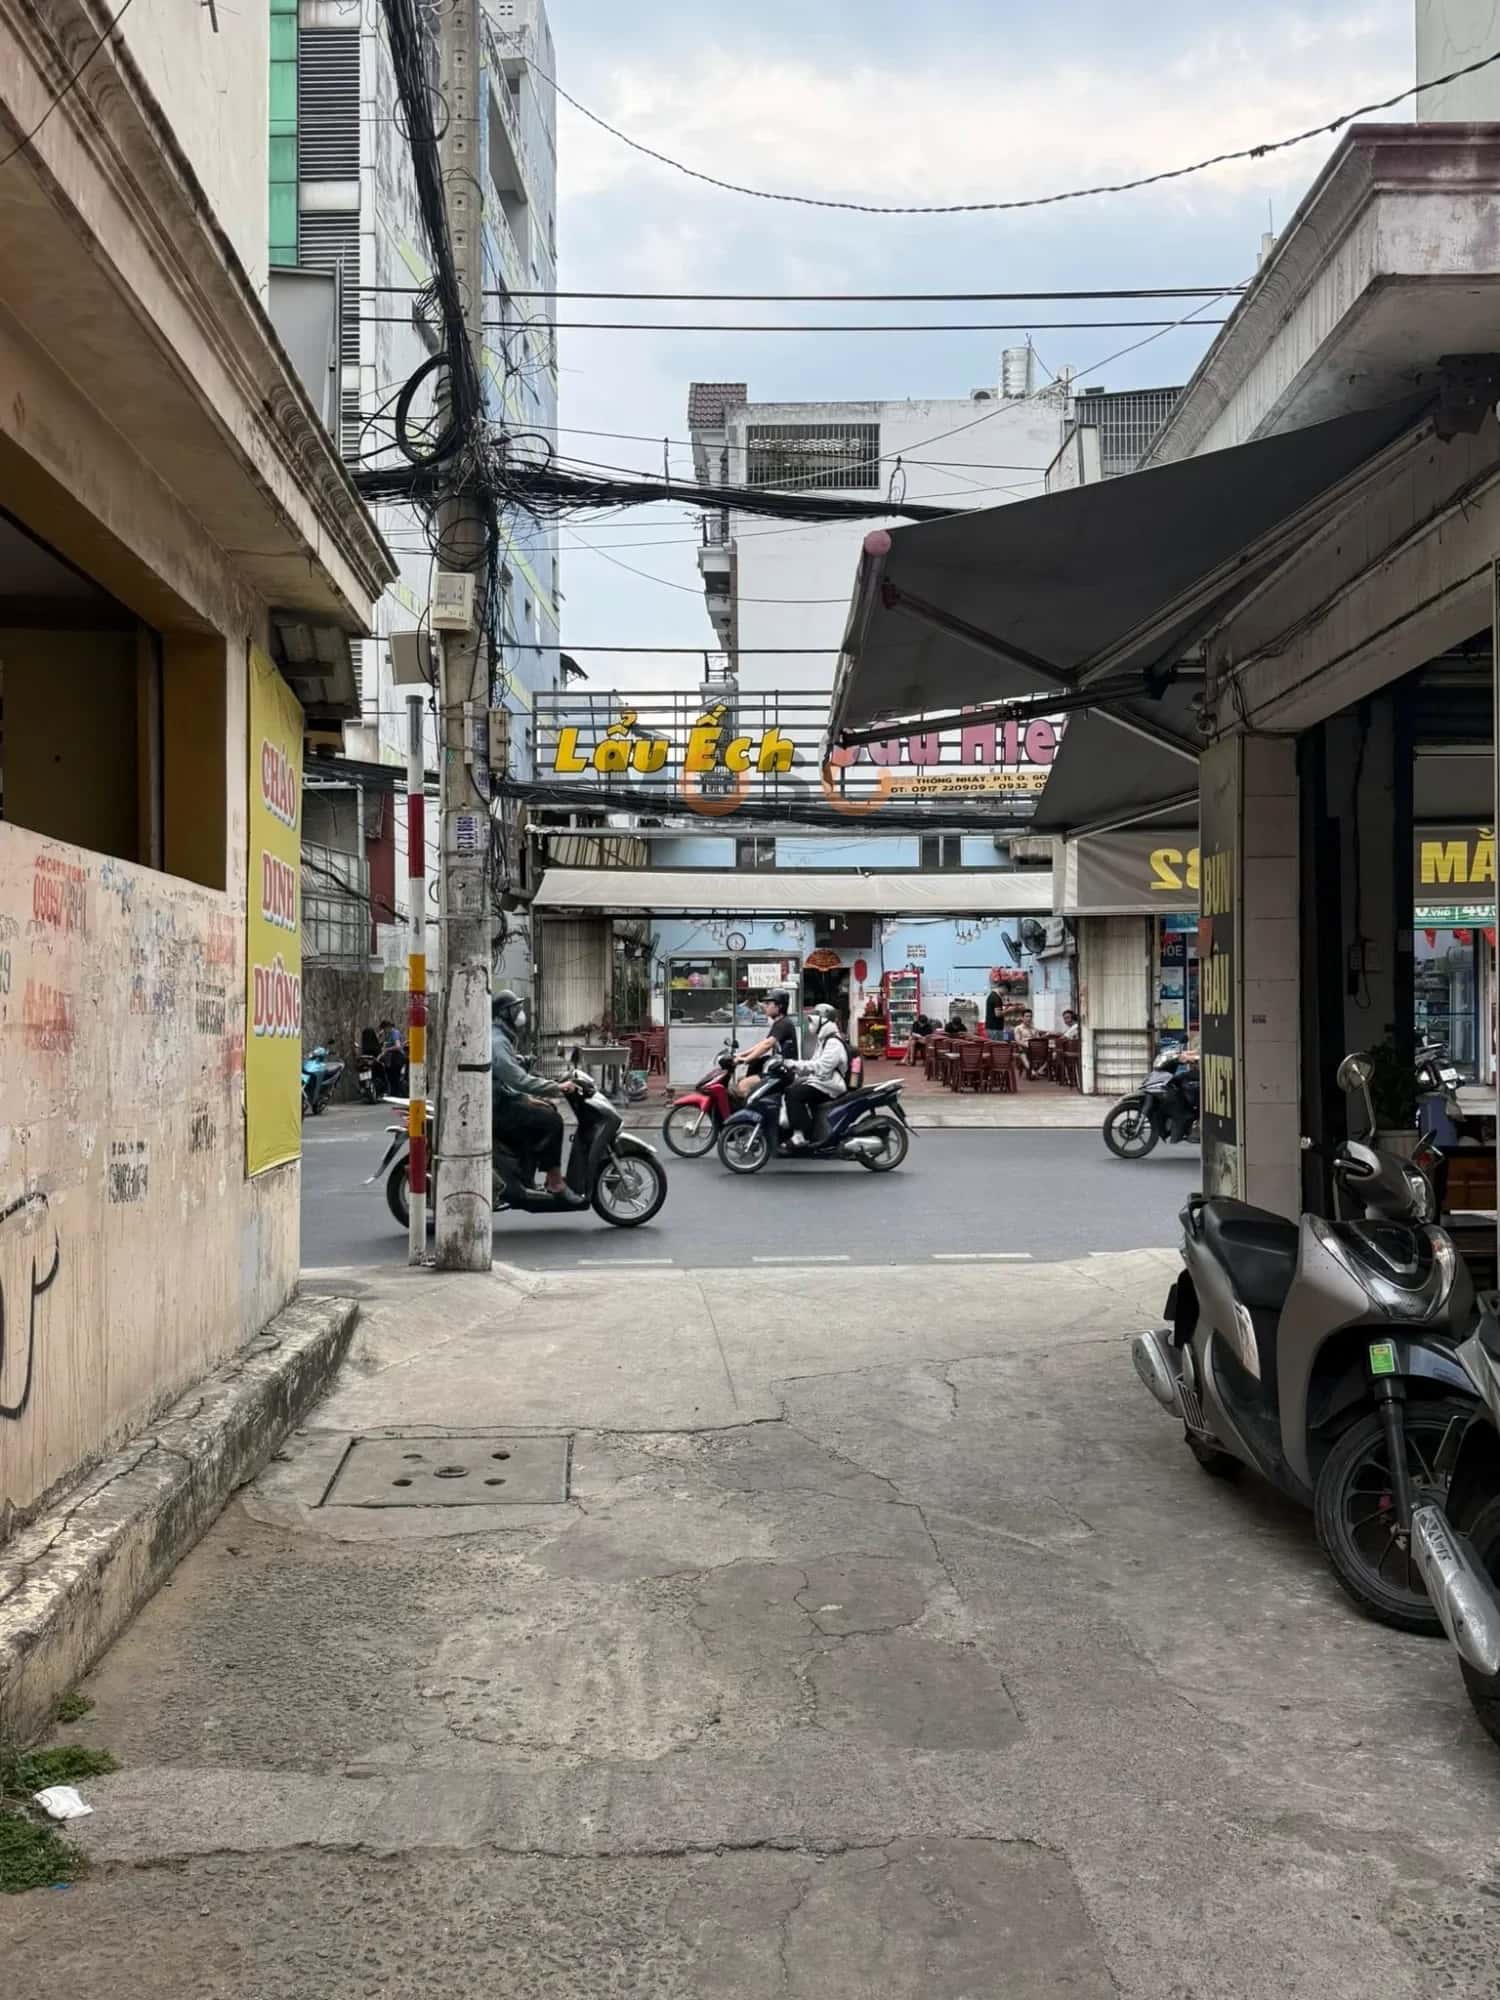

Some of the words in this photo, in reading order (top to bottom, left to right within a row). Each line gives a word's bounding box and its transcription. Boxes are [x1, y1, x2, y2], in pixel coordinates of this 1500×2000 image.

[553, 698, 671, 774] Lẩu
[685, 703, 795, 774] Ếch
[262, 738, 297, 830] CHÁO
[261, 852, 296, 931] DINH
[1204, 1053, 1233, 1129] MẸT
